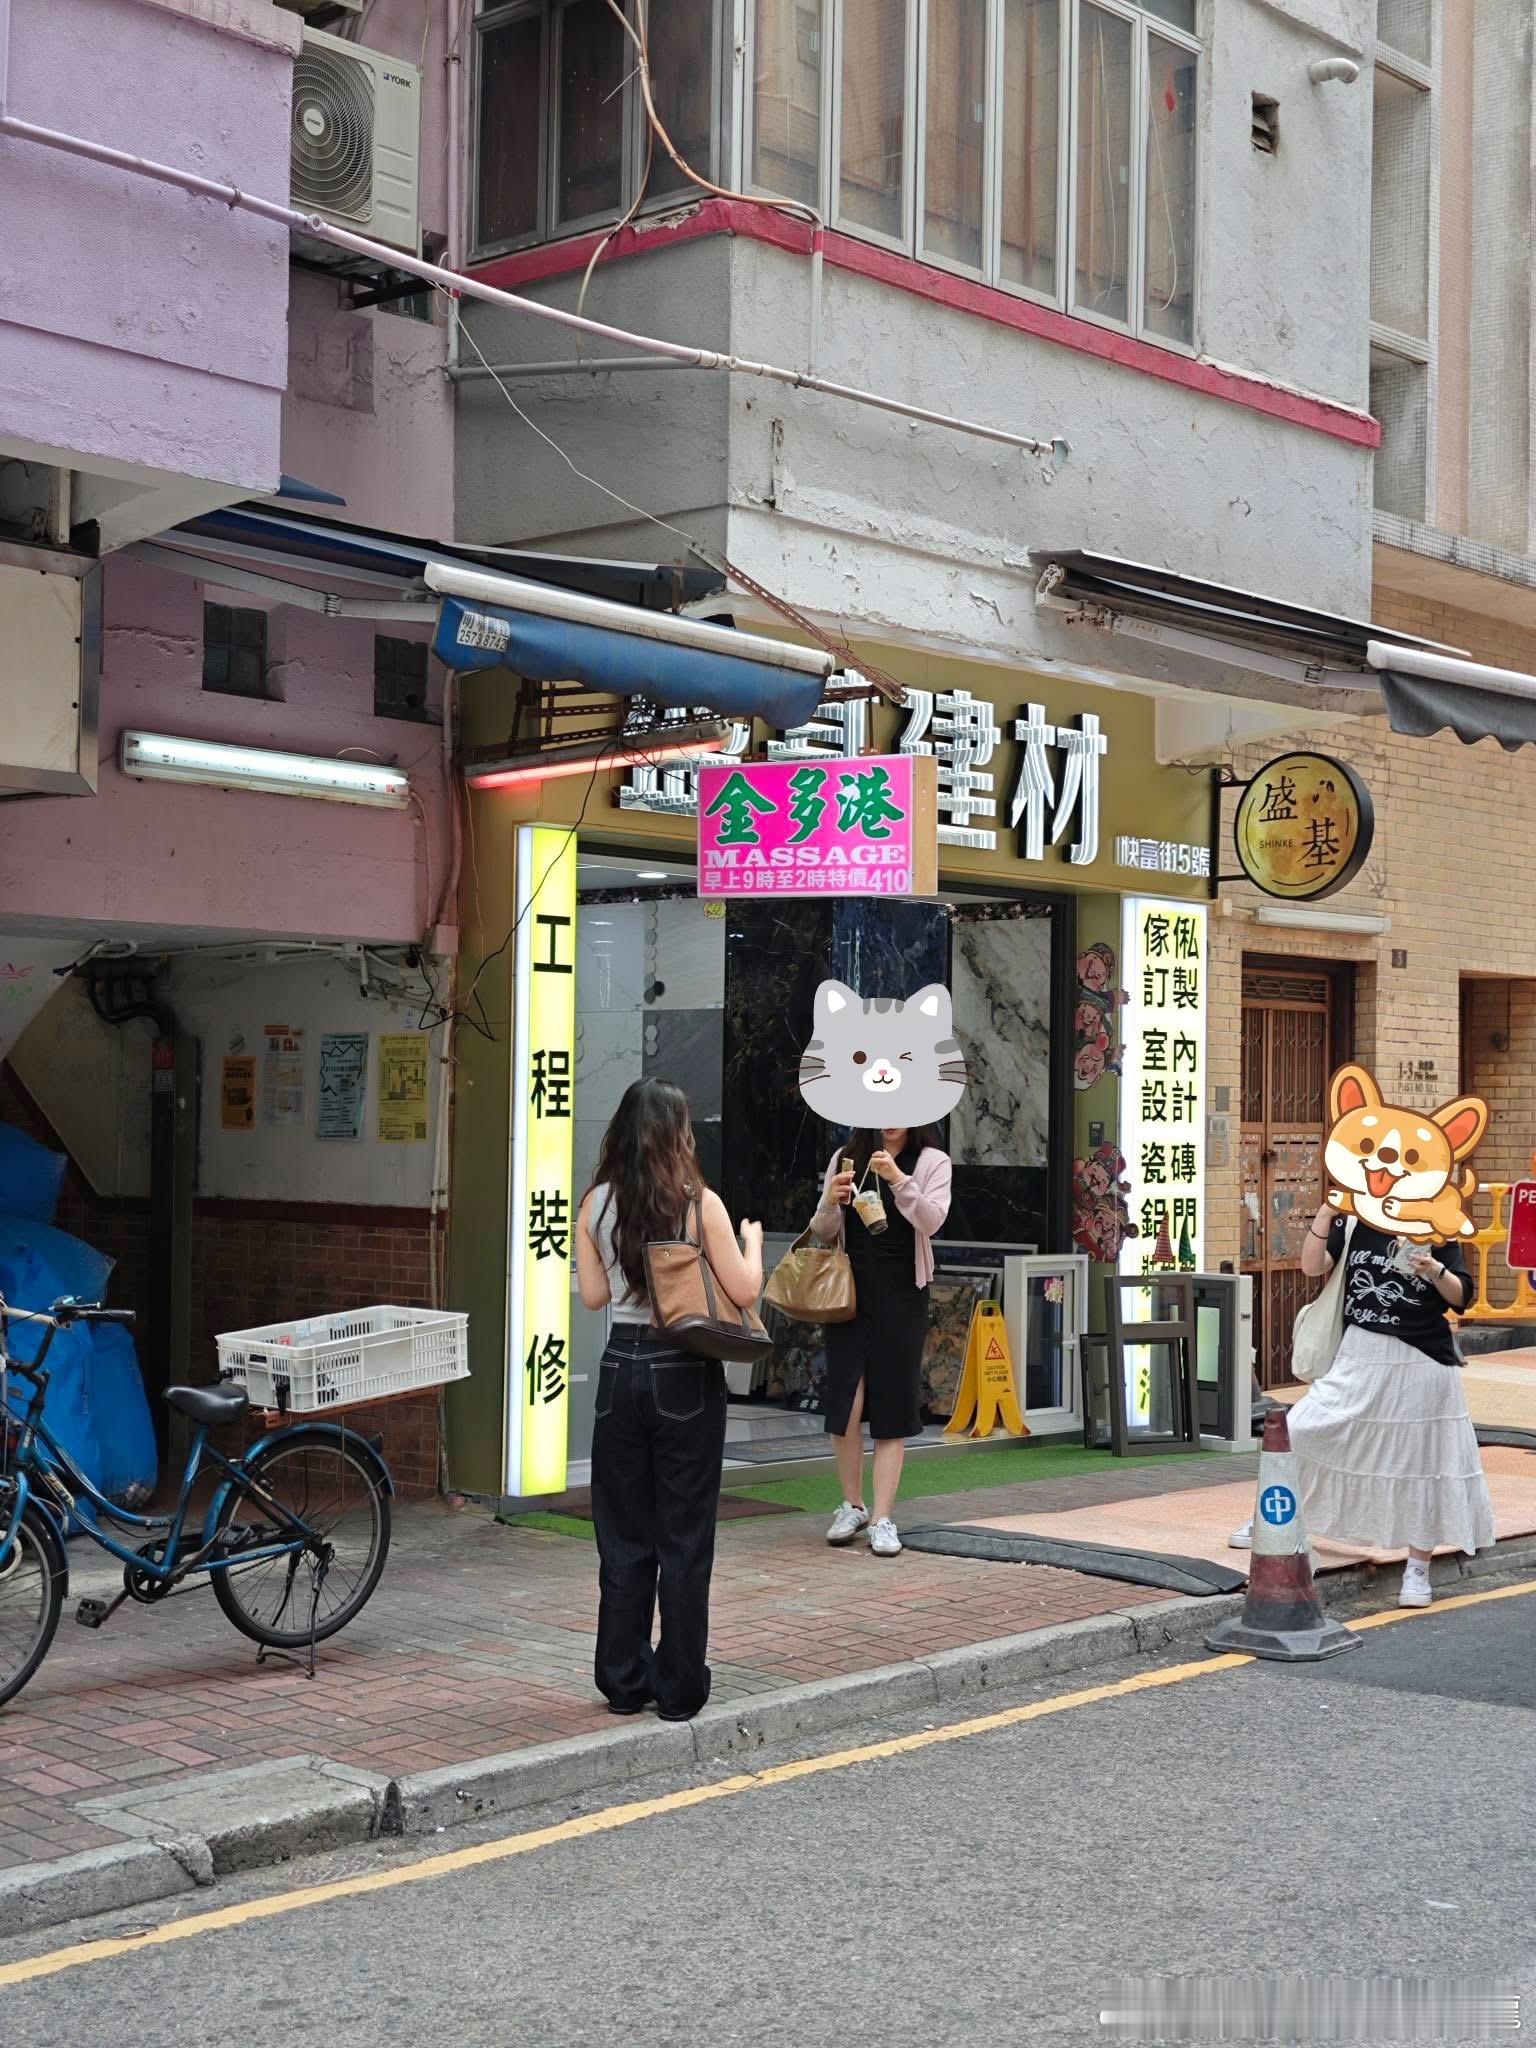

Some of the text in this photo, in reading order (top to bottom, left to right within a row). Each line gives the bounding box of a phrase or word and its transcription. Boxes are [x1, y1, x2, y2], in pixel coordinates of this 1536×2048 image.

[390, 74, 411, 88] YORK
[705, 766, 905, 845] 金多港
[704, 845, 906, 868] MASSAGE
[1259, 839, 1294, 849] SHINKE
[1141, 1080, 1198, 1124] 設計
[526, 913, 573, 1406] 工程裝修
[1141, 1142, 1197, 1184] 瓷磚
